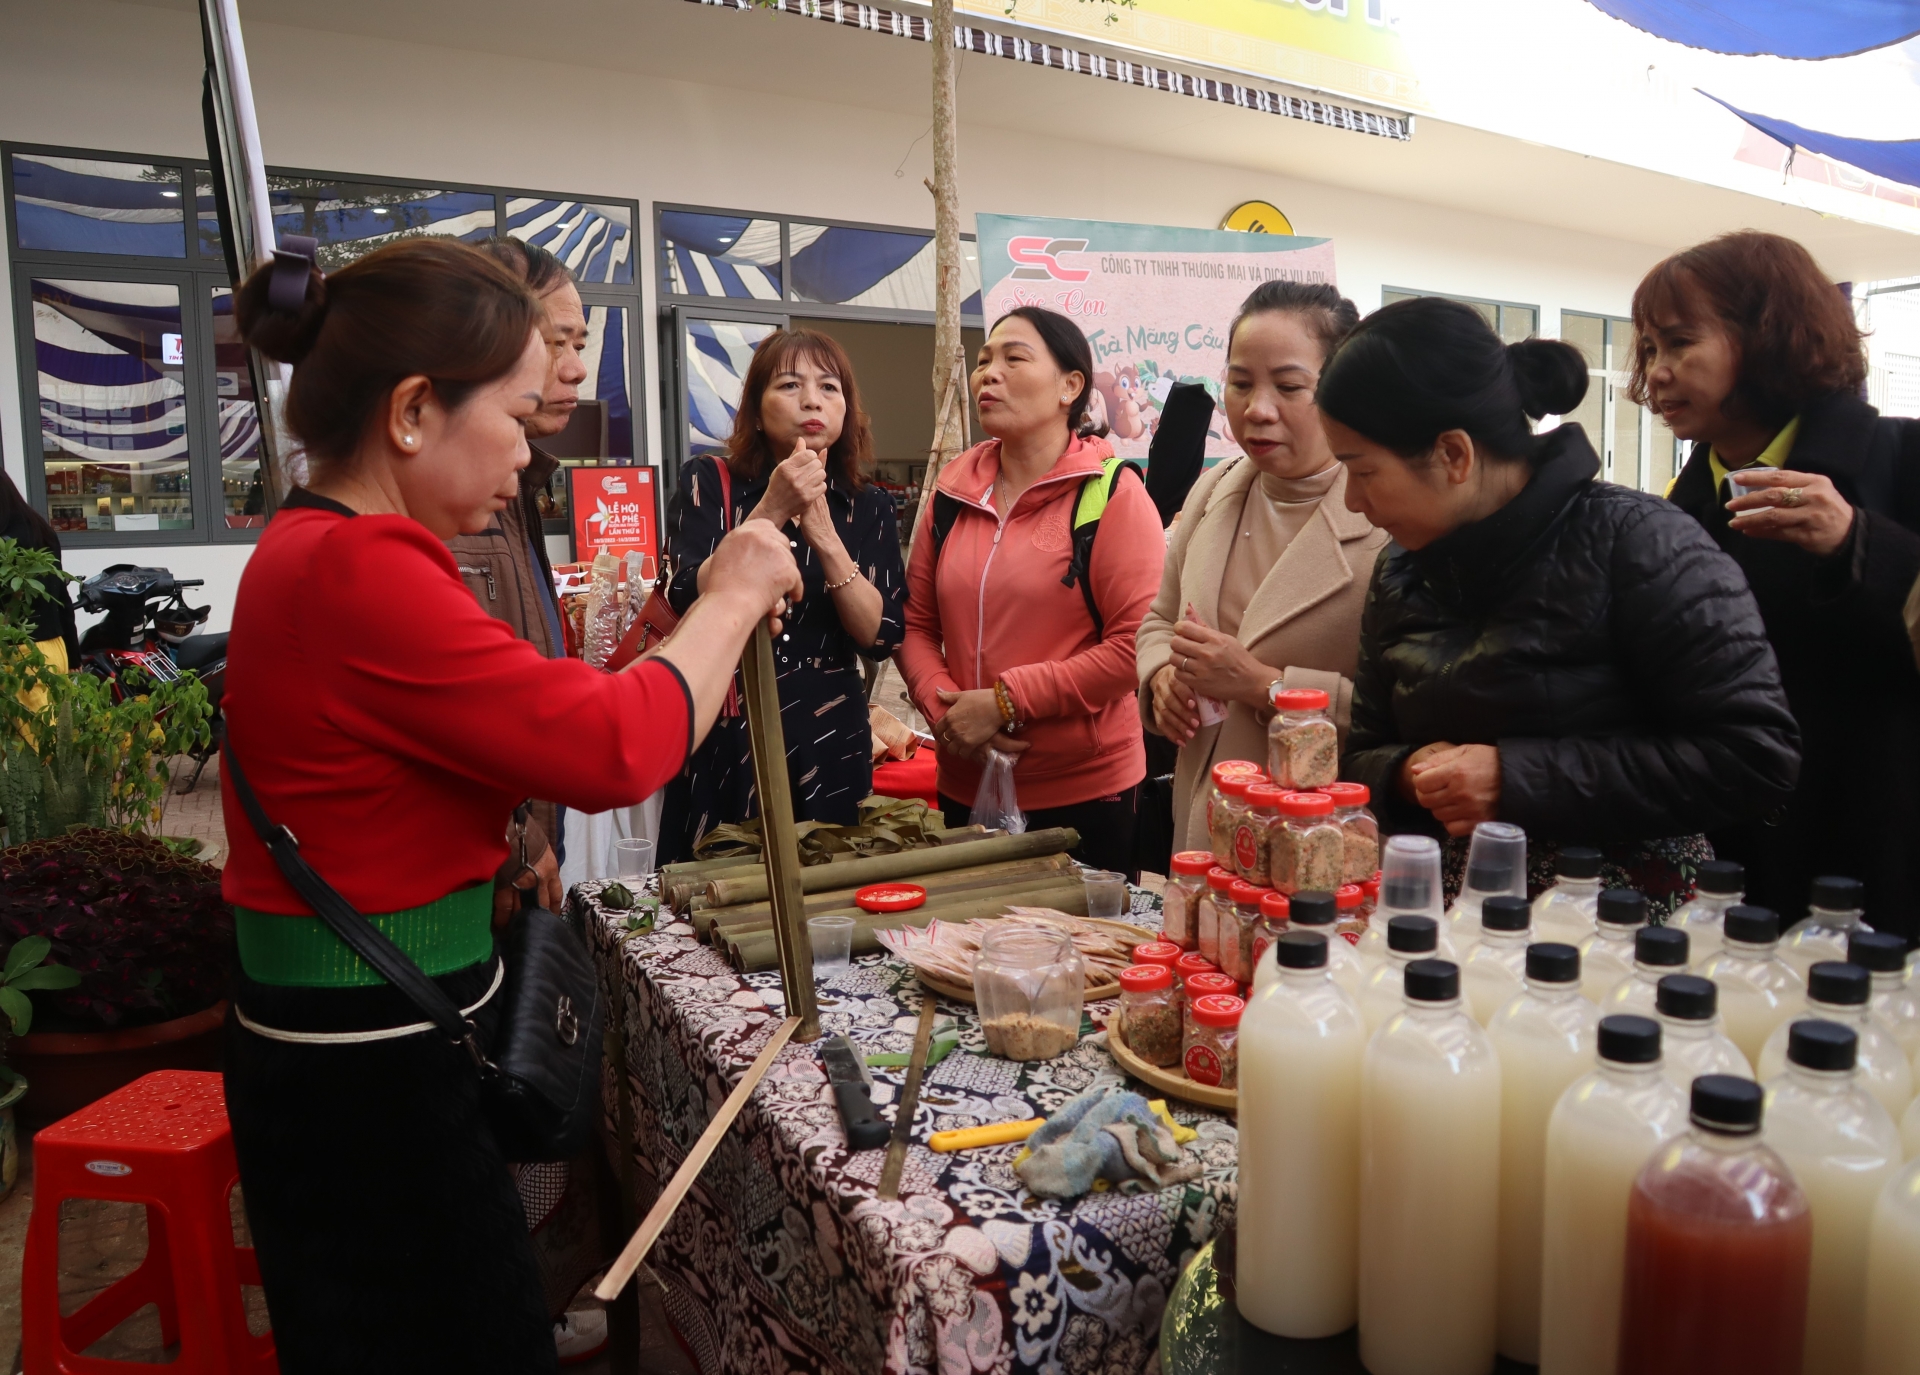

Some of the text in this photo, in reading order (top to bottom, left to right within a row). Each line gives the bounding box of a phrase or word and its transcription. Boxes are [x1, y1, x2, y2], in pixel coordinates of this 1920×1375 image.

[1101, 253, 1131, 275] CÔNG
[1133, 259, 1147, 275] TY
[1150, 259, 1180, 277] TNHH
[1227, 263, 1246, 283] MẠI
[1248, 263, 1262, 281] VÀ
[1055, 288, 1106, 314] Con
[1086, 323, 1224, 364] Trà Mãng Cầu
[608, 513, 639, 524] CÀ PHÊ
[621, 502, 639, 515] HỘI
